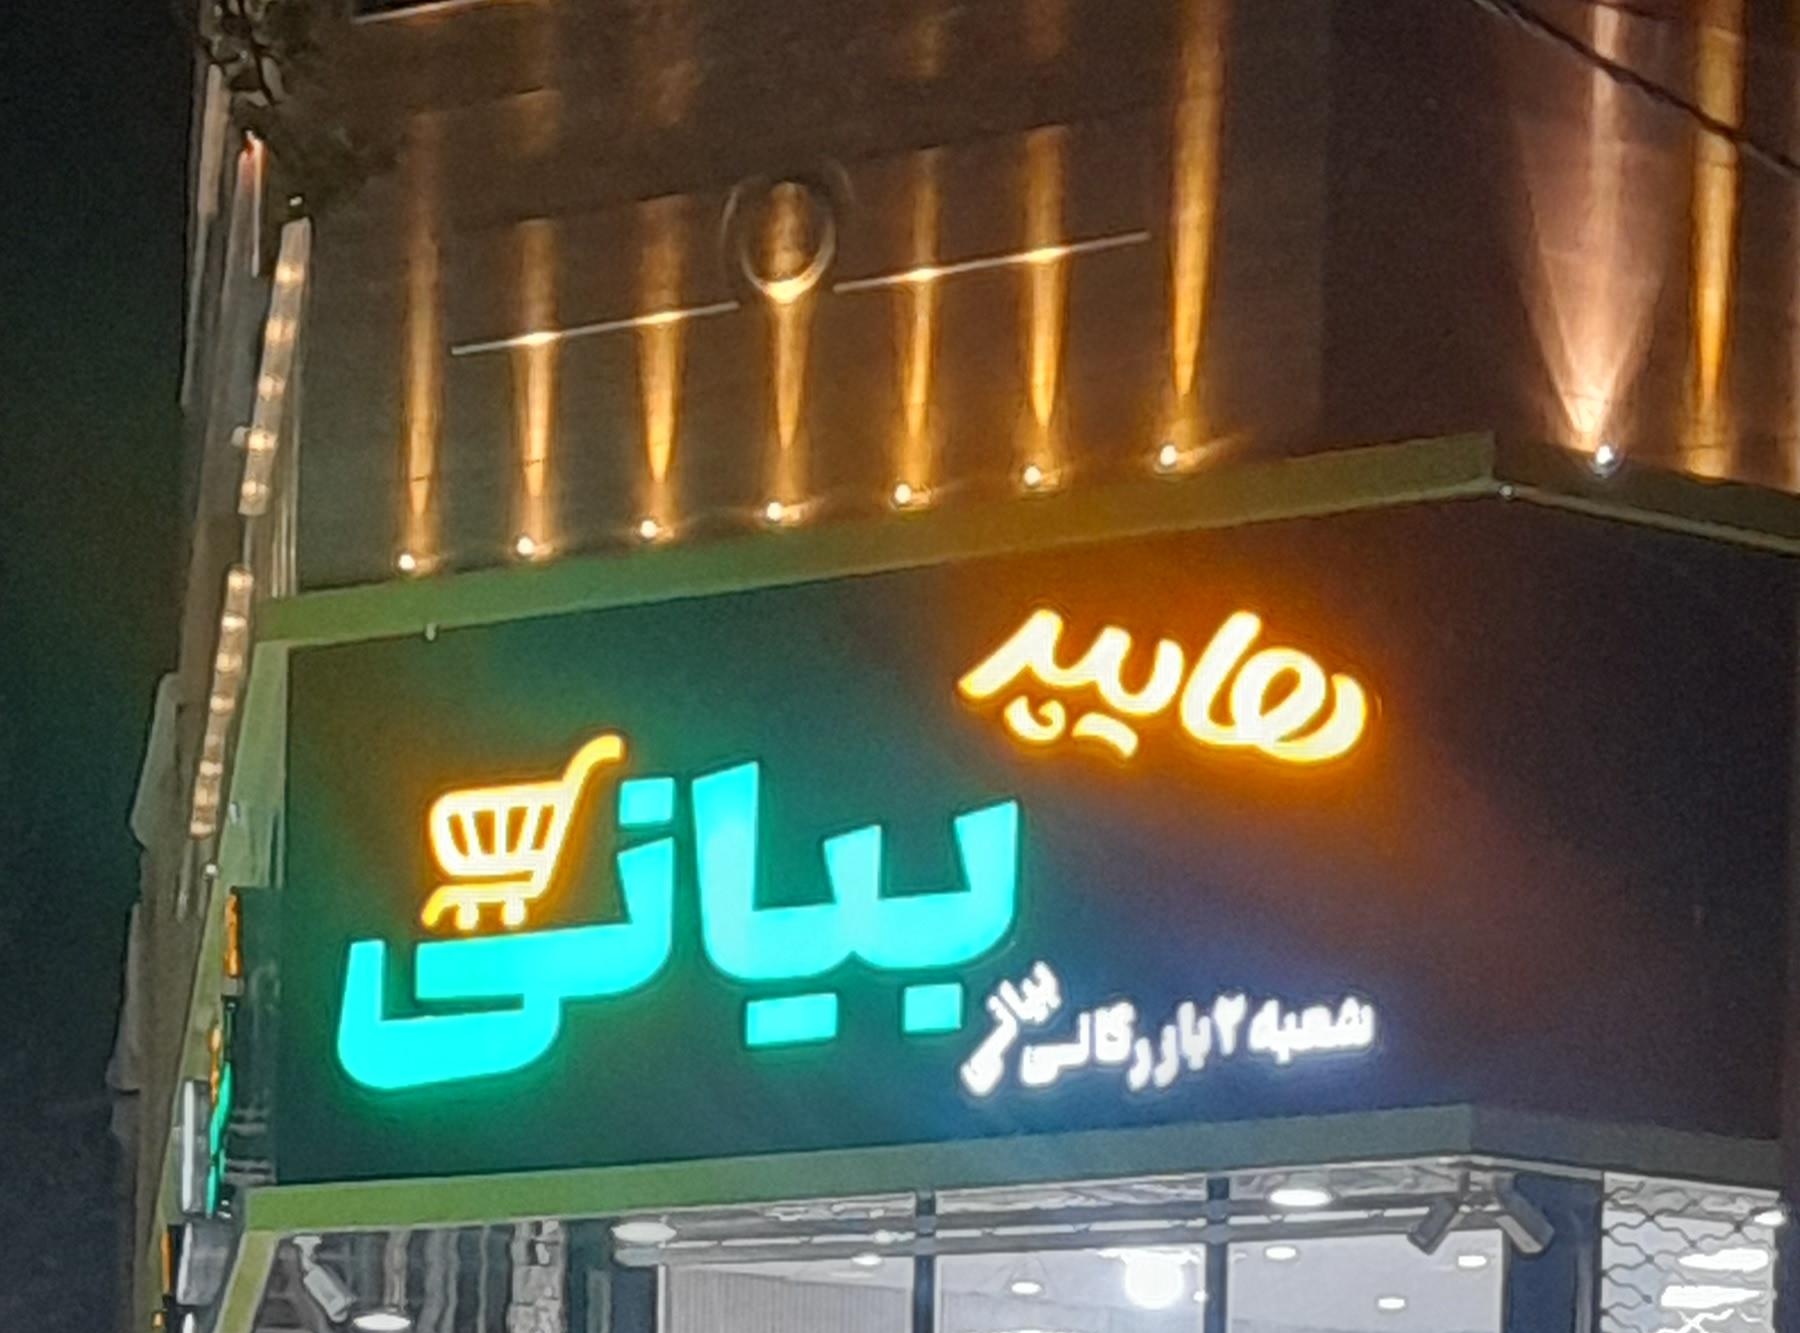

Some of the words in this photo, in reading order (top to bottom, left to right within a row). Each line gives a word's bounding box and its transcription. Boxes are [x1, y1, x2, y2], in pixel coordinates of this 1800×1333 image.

[957, 607, 1368, 763] هایپر
[335, 759, 1020, 1091] بیانی
[1248, 996, 1377, 1065] شعبه
